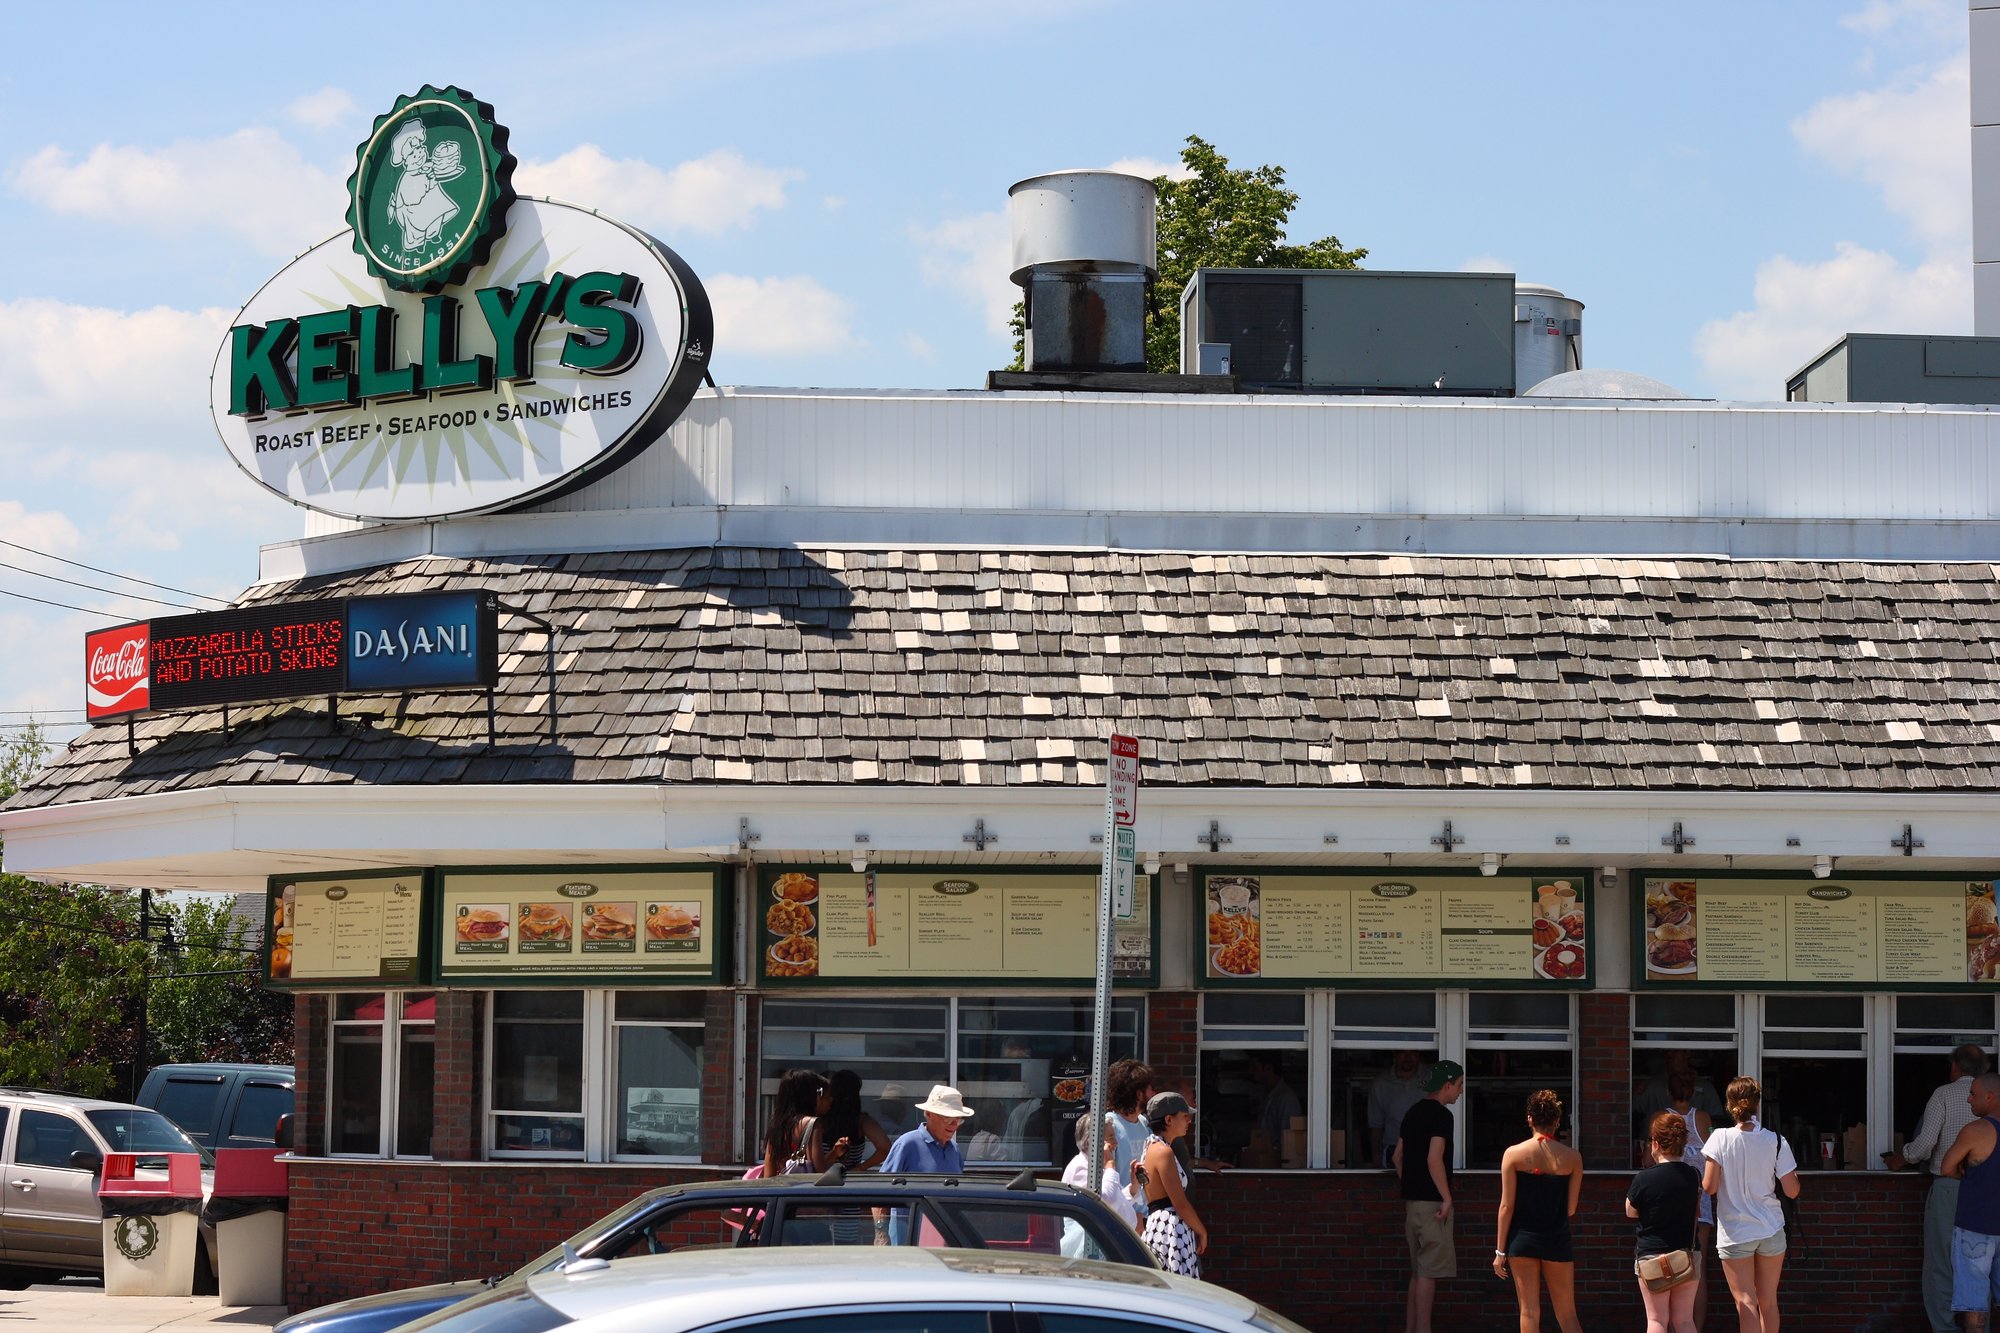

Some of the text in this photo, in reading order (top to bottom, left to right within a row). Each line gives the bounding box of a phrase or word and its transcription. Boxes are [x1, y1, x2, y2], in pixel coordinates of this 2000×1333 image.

[380, 231, 462, 267] SINCE 1951
[228, 271, 642, 419] KELLY'S
[255, 390, 633, 454] ROAST BEEF SEAFOOD SANDWICHES
[151, 619, 342, 661] MOZZARELLA STICKS
[354, 618, 468, 664] DASANI
[89, 637, 146, 686] Coca-Cola
[156, 644, 337, 684] AND POTATO SKINS
[1116, 758, 1127, 770] NO
[1121, 742, 1137, 753] ZONE
